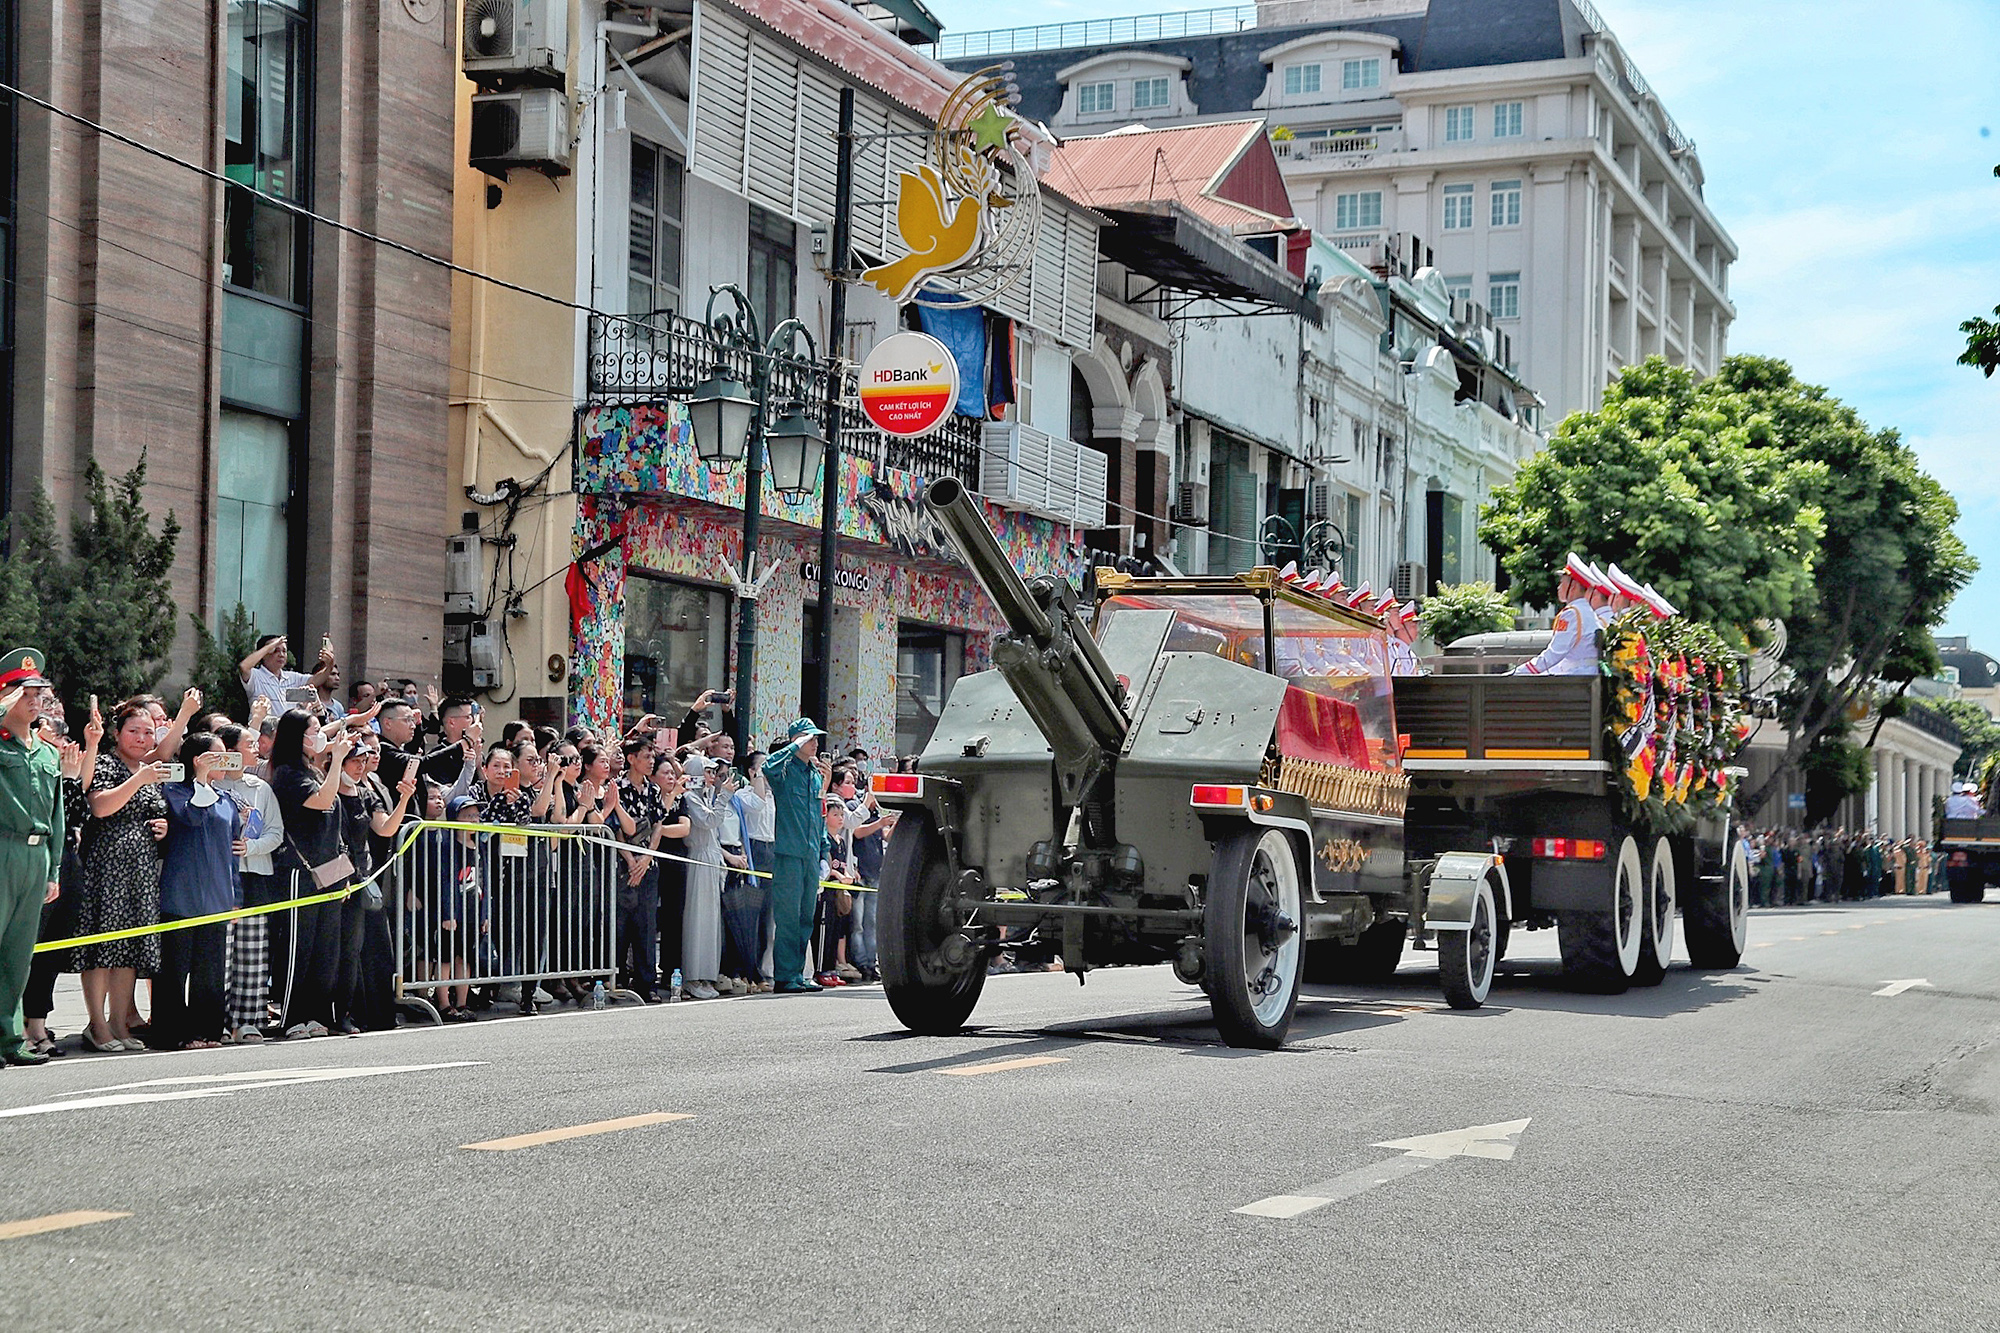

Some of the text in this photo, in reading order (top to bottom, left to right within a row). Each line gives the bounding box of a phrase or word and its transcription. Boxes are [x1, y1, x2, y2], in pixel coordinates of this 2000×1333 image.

[874, 368, 927, 382] HDBank
[879, 403, 894, 411] CAM
[834, 569, 870, 590] KONGO
[548, 653, 566, 683] 9
